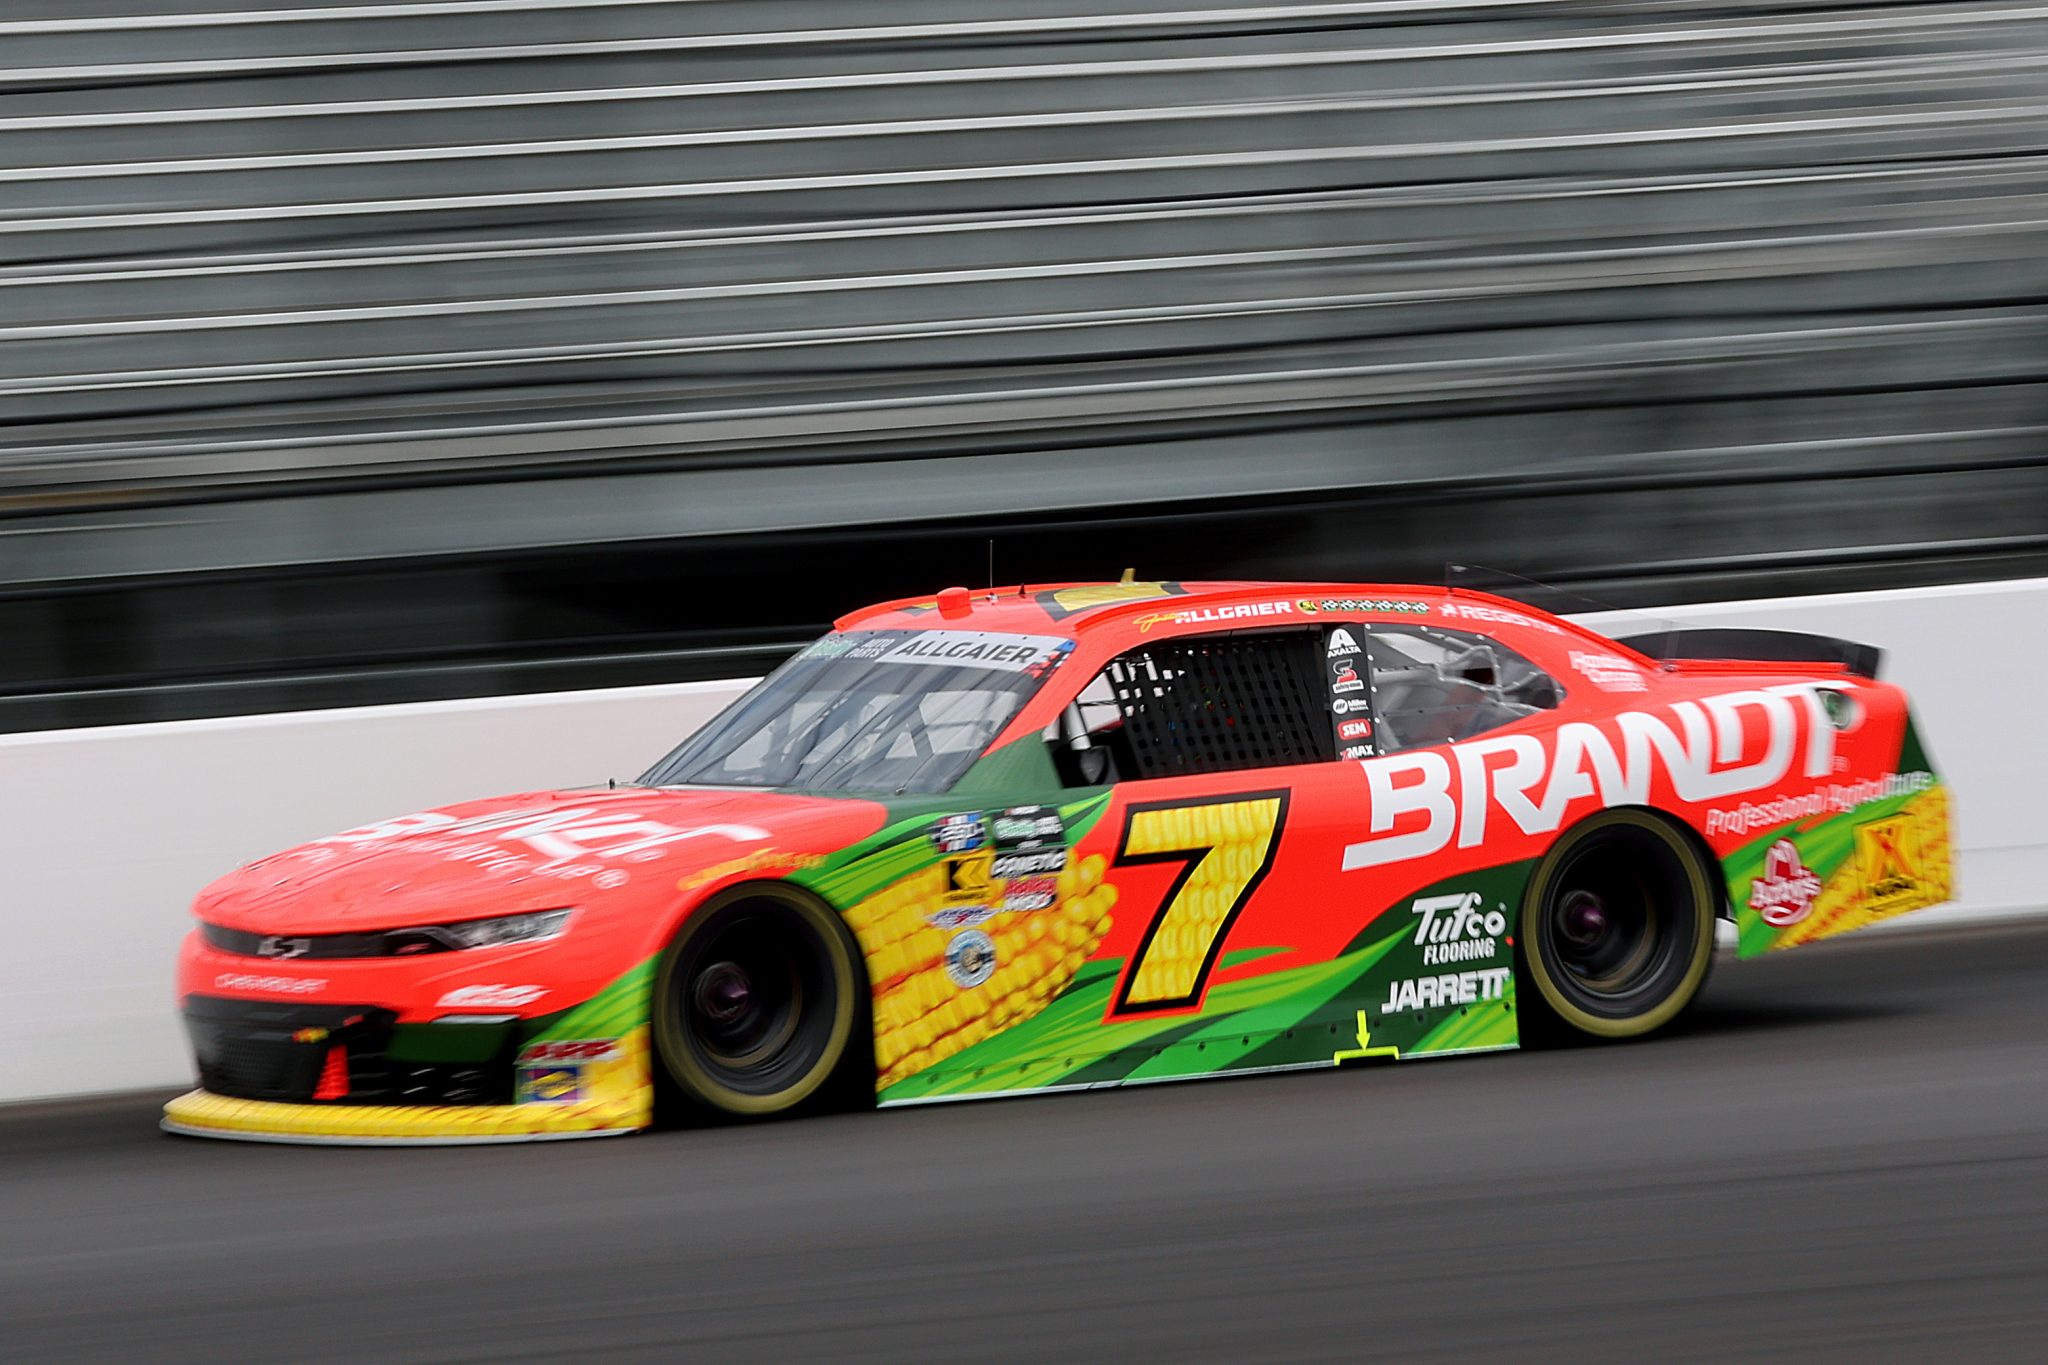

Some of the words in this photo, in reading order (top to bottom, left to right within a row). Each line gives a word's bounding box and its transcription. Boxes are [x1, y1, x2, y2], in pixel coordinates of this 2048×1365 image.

[1174, 601, 1293, 625] ALLGAIER
[895, 638, 1039, 664] ALLGAIER
[1327, 646, 1361, 658] AXALTA
[1343, 723, 1366, 737] SEM
[1342, 679, 1860, 873] BRANDT
[1113, 787, 1291, 1015] 7
[1412, 891, 1507, 946] Tufco
[1423, 937, 1497, 966] FLOORING
[1381, 965, 1512, 1014] JARRETT
